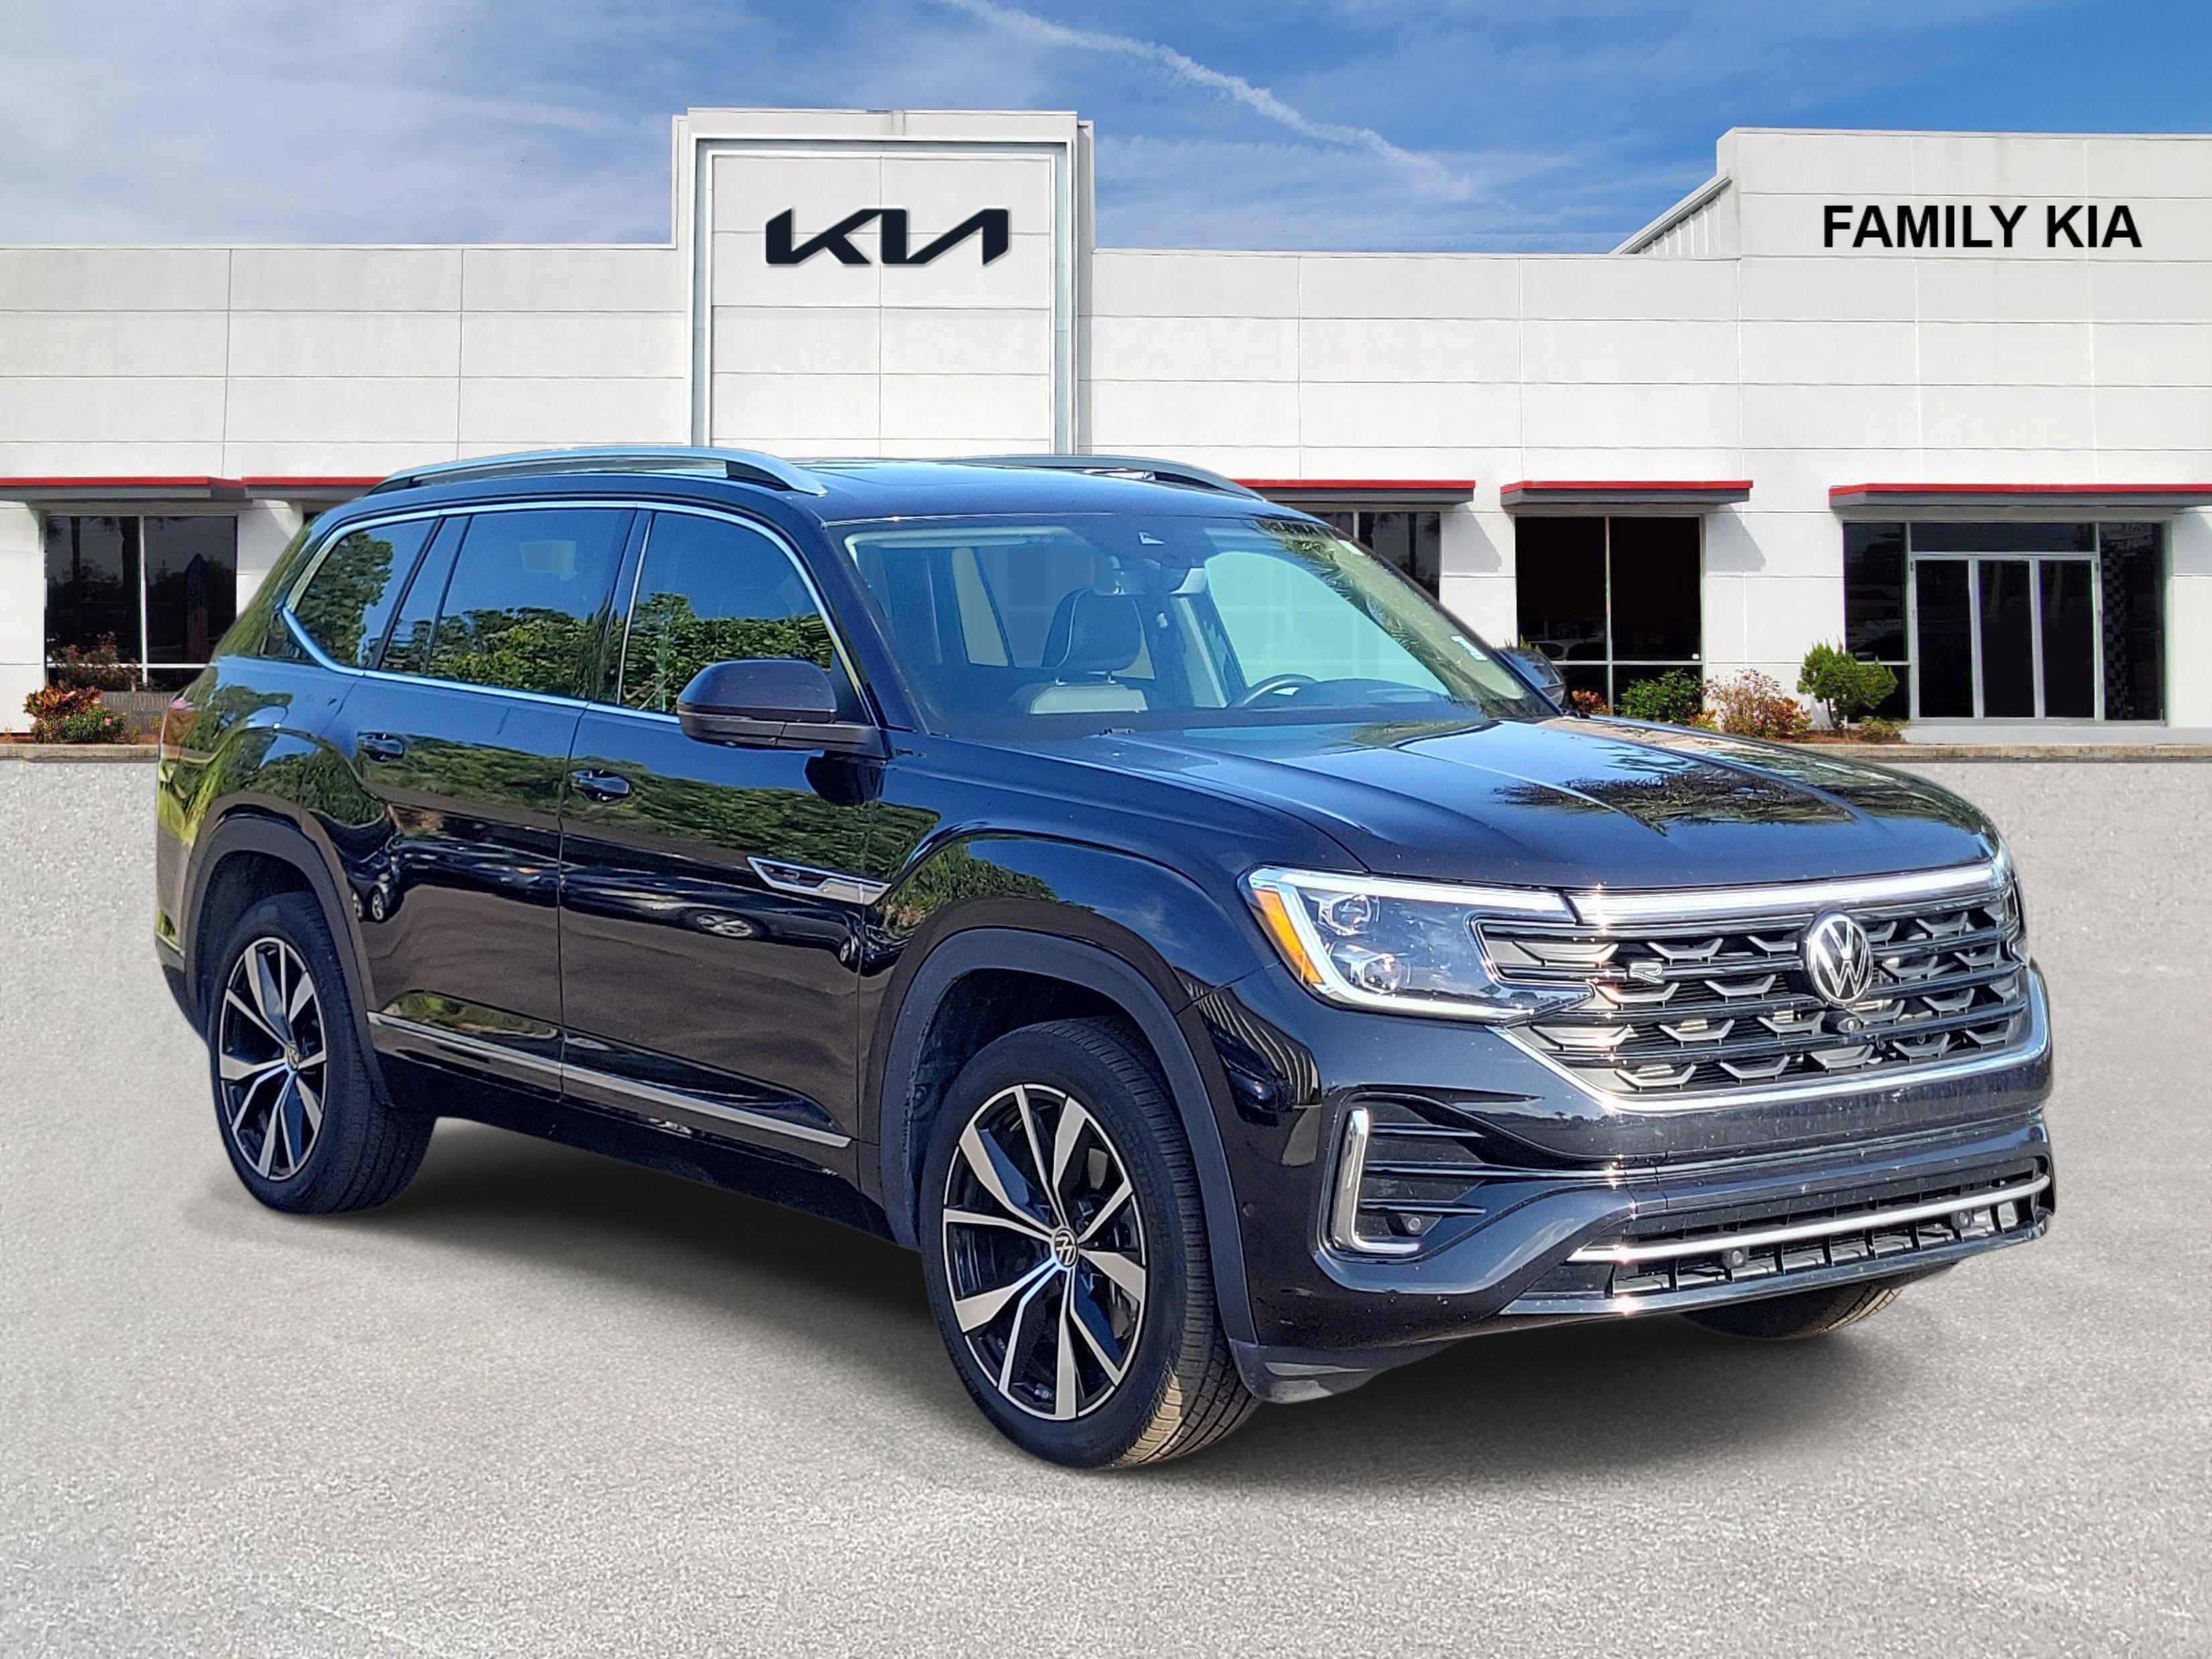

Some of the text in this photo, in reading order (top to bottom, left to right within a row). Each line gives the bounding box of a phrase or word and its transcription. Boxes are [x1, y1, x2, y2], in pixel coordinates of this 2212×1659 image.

[766, 208, 1009, 265] KIA
[1824, 205, 2142, 248] FAMILY KIA
[1809, 915, 1872, 1003] VW
